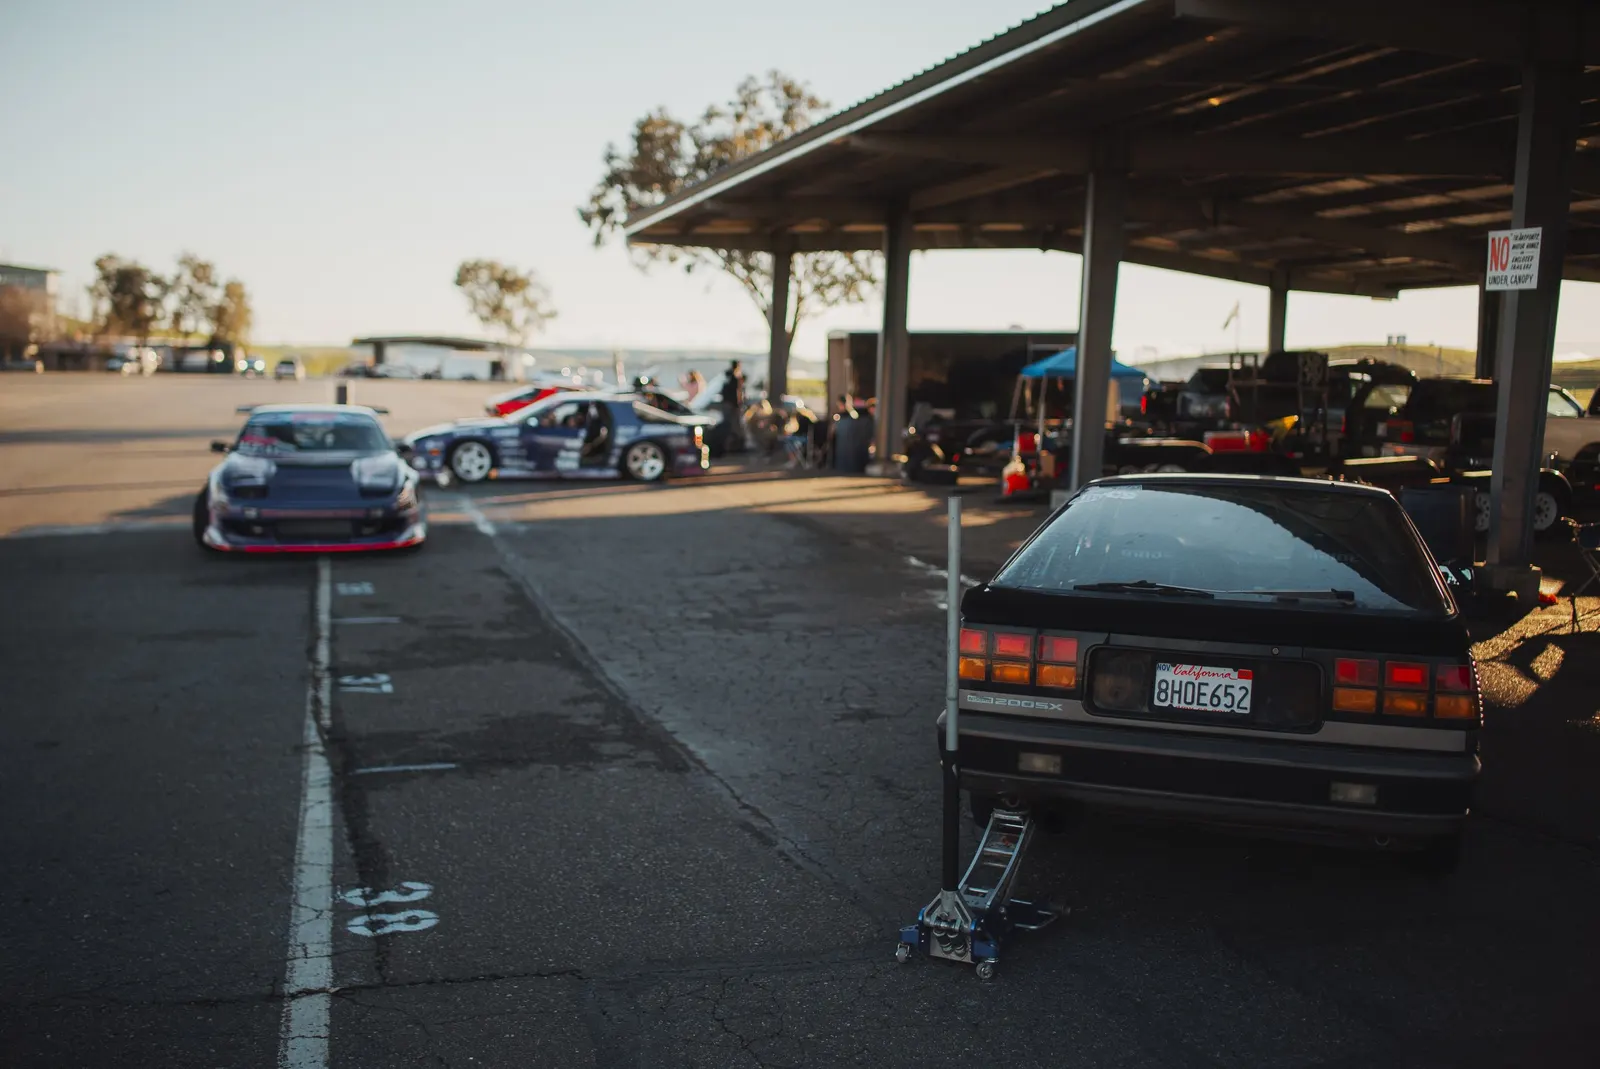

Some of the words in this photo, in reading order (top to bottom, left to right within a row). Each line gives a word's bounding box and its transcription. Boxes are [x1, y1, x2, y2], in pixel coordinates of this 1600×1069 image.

[1490, 236, 1510, 272] NO
[1488, 275, 1509, 286] UNDER
[1510, 273, 1534, 285] CANOPY
[1157, 663, 1171, 671] NOV
[1173, 663, 1238, 681] California
[995, 697, 1064, 712] 200SX
